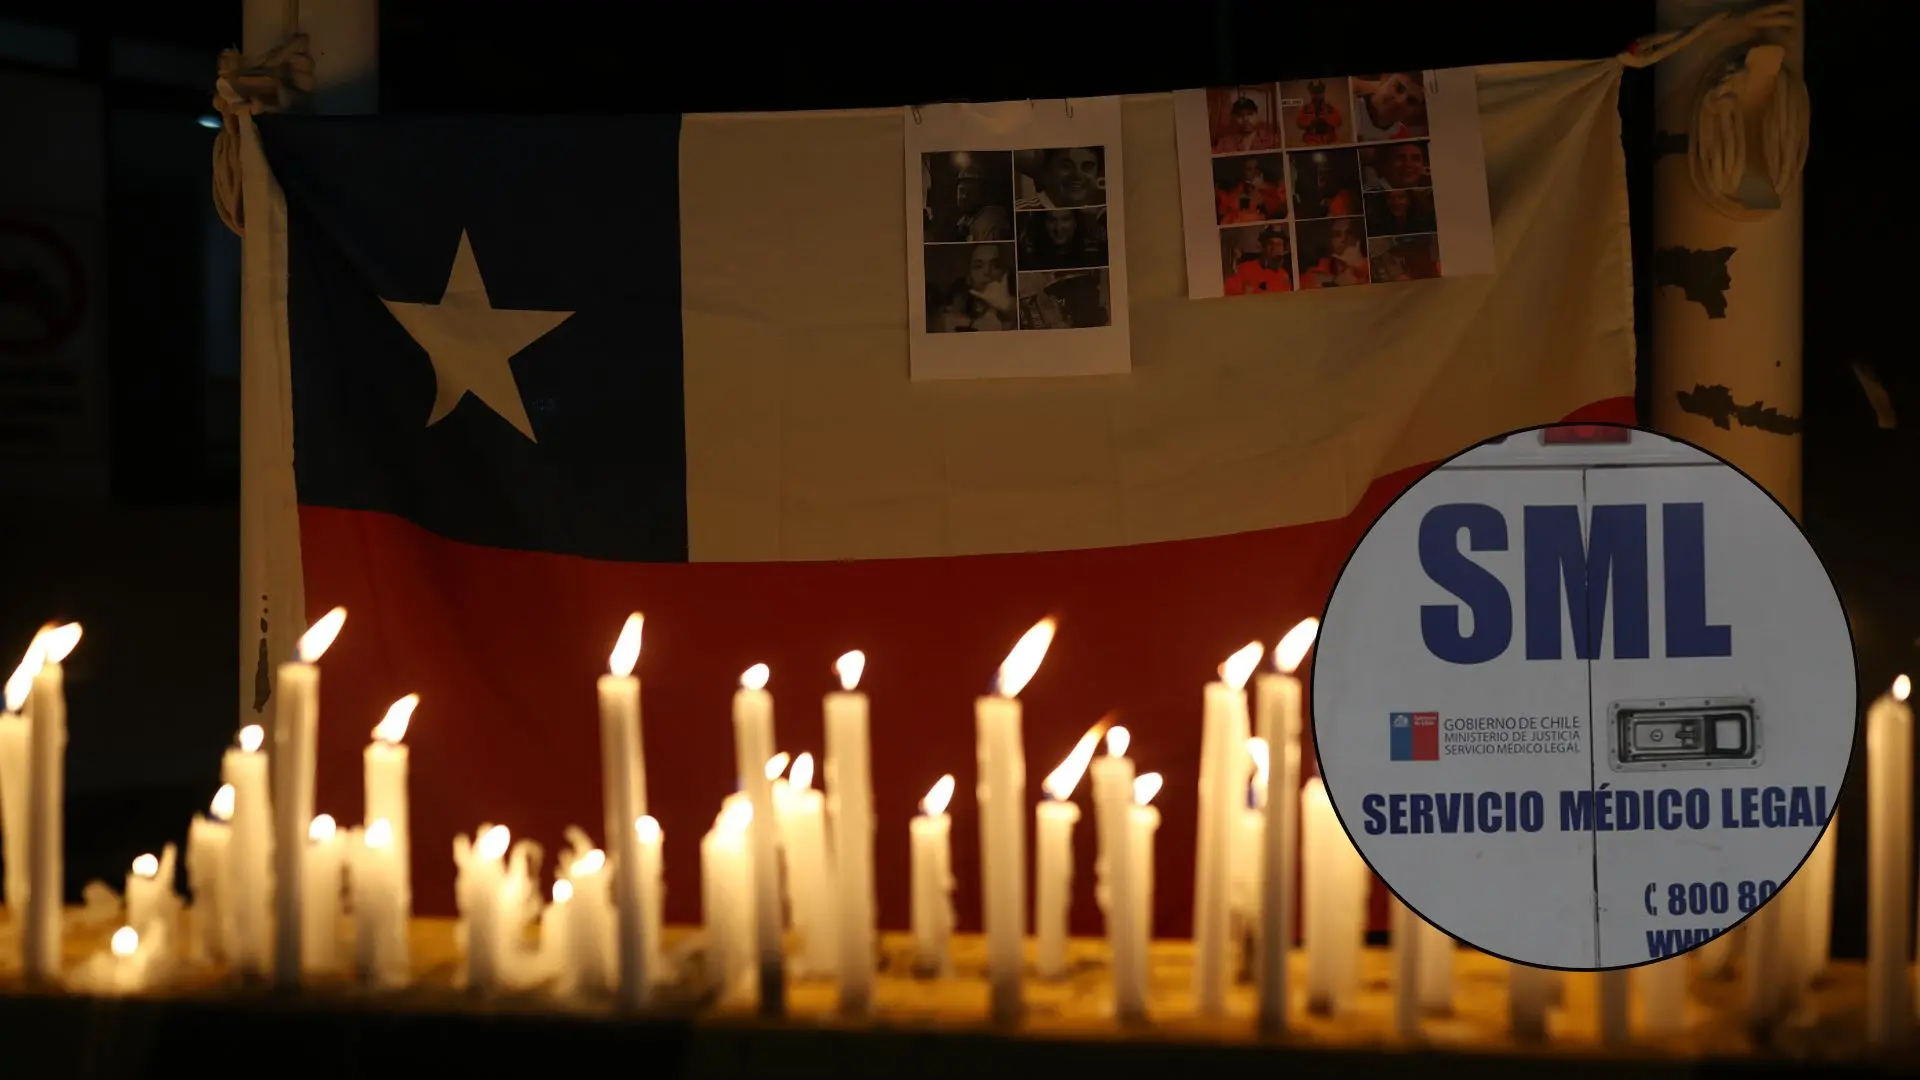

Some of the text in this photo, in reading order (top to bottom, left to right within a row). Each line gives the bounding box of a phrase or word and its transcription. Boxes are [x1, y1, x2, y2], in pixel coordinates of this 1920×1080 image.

[1418, 502, 1732, 664] SML
[1443, 717, 1517, 731] GOBIERNO
[1519, 717, 1537, 730] DE
[1540, 716, 1581, 729] CHILE
[1444, 730, 1581, 743] MINISTERIO DE JUSTICIA
[1445, 744, 1495, 756] SERVICIO
[1544, 742, 1581, 754] LEGAL
[1362, 783, 1829, 836] SERVICIO MÉDICO LEGAL
[1668, 881, 1729, 916] 800
